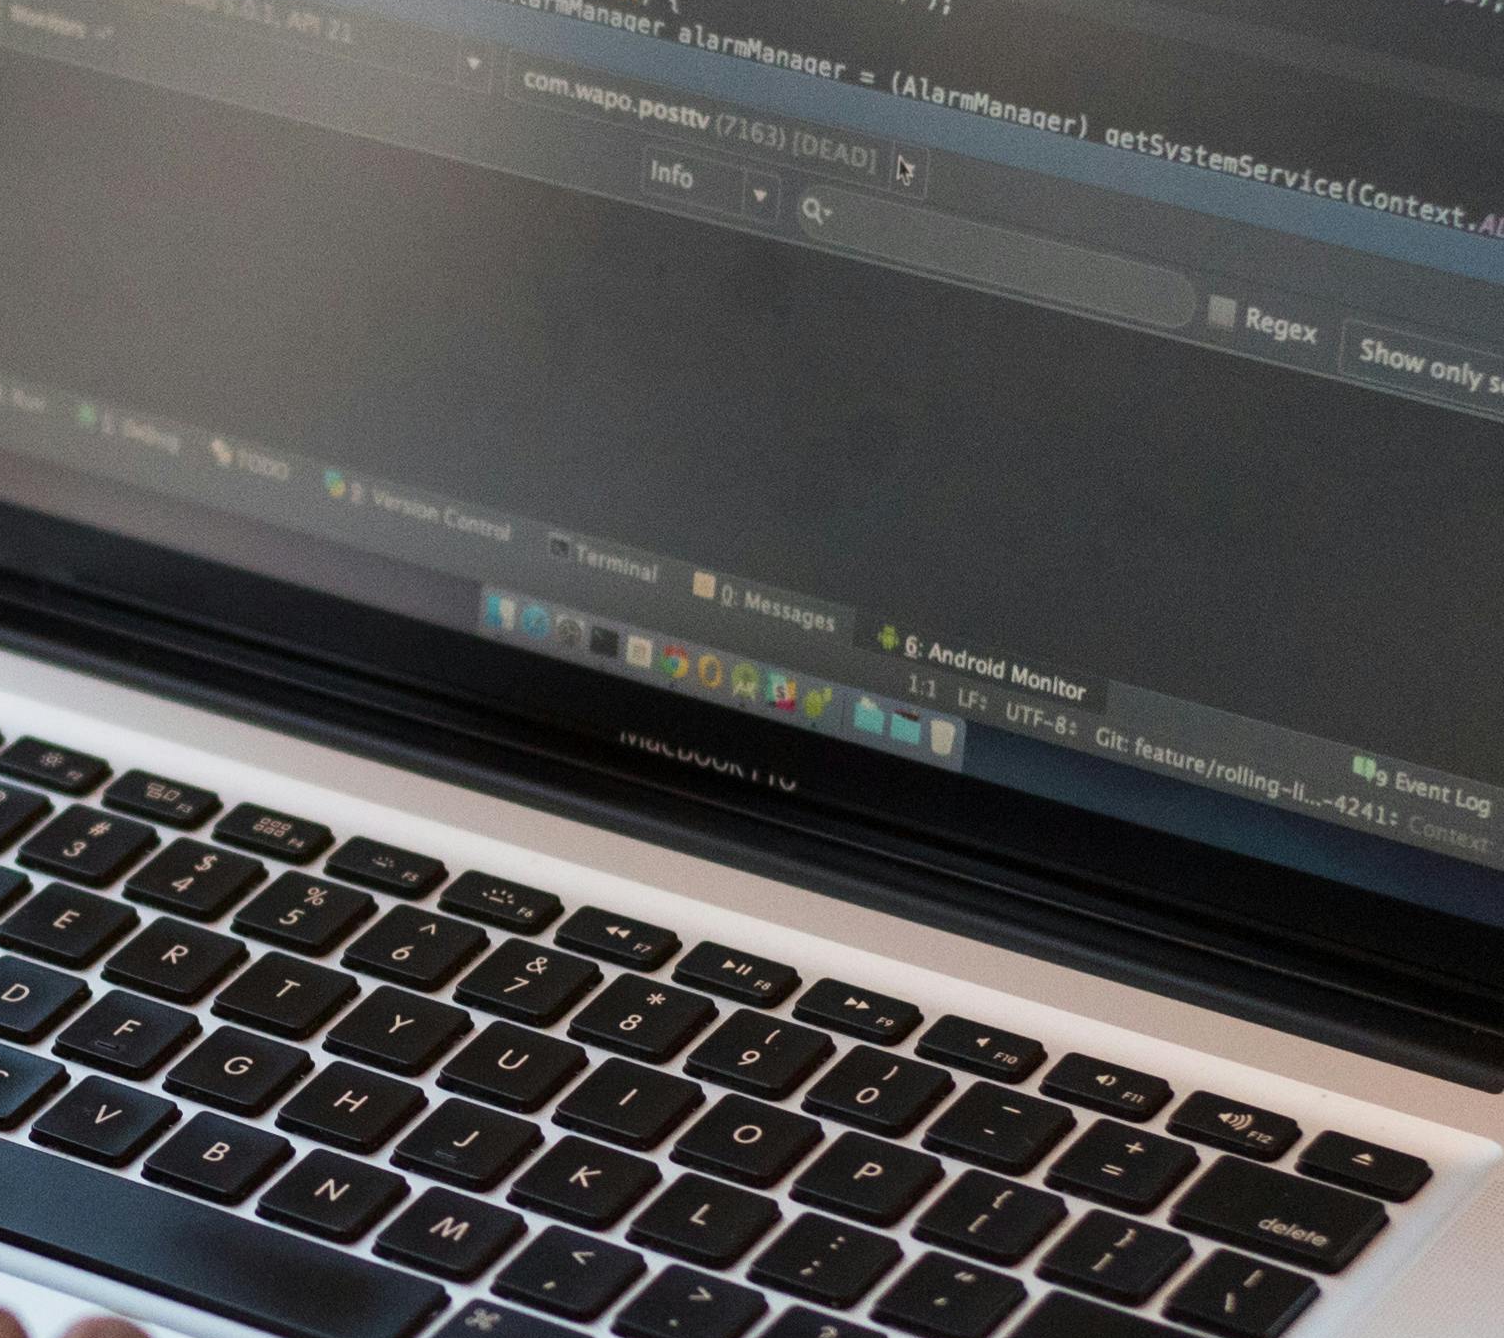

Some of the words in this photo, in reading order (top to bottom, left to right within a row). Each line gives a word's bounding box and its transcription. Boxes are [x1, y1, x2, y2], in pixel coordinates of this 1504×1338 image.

[523, 73, 710, 130] com.wapo.posttv
[715, 114, 786, 152] (7163)
[791, 132, 879, 175] [DEAD]
[651, 160, 694, 189] Info
[1244, 307, 1318, 345] Regex
[1358, 339, 1424, 373] Show
[1429, 361, 1483, 392] only
[576, 543, 658, 584] Terminal
[743, 590, 836, 633] Messages
[903, 635, 924, 658] 6:
[927, 642, 1005, 681] Android
[1009, 664, 1087, 703] Monitor
[908, 674, 937, 699] 1:1
[1095, 727, 1129, 753] Git:
[1394, 770, 1445, 802] Event
[1449, 785, 1492, 819] Log
[62, 840, 87, 858] 3
[171, 875, 196, 893] 4
[52, 909, 80, 930] E
[278, 908, 305, 925] 5
[161, 944, 189, 965] R
[391, 945, 414, 961] 6
[0, 983, 30, 1003] D
[276, 979, 301, 998] T
[503, 976, 530, 993] 7
[113, 1019, 142, 1036] F
[388, 1014, 414, 1034] Y
[618, 1013, 643, 1031] 8
[223, 1056, 254, 1076] G
[497, 1049, 530, 1070] U
[738, 1049, 761, 1066] 9
[333, 1090, 369, 1113] H
[618, 1088, 638, 1106] I
[855, 1086, 880, 1104] 0
[94, 1104, 122, 1124] V
[452, 1130, 480, 1148] J
[732, 1124, 763, 1144] O
[202, 1141, 231, 1162] B
[569, 1165, 602, 1188] K
[853, 1161, 883, 1180] P
[314, 1178, 350, 1202] N
[689, 1203, 710, 1226] L
[430, 1216, 470, 1241] M
[1258, 1218, 1329, 1247] delete
